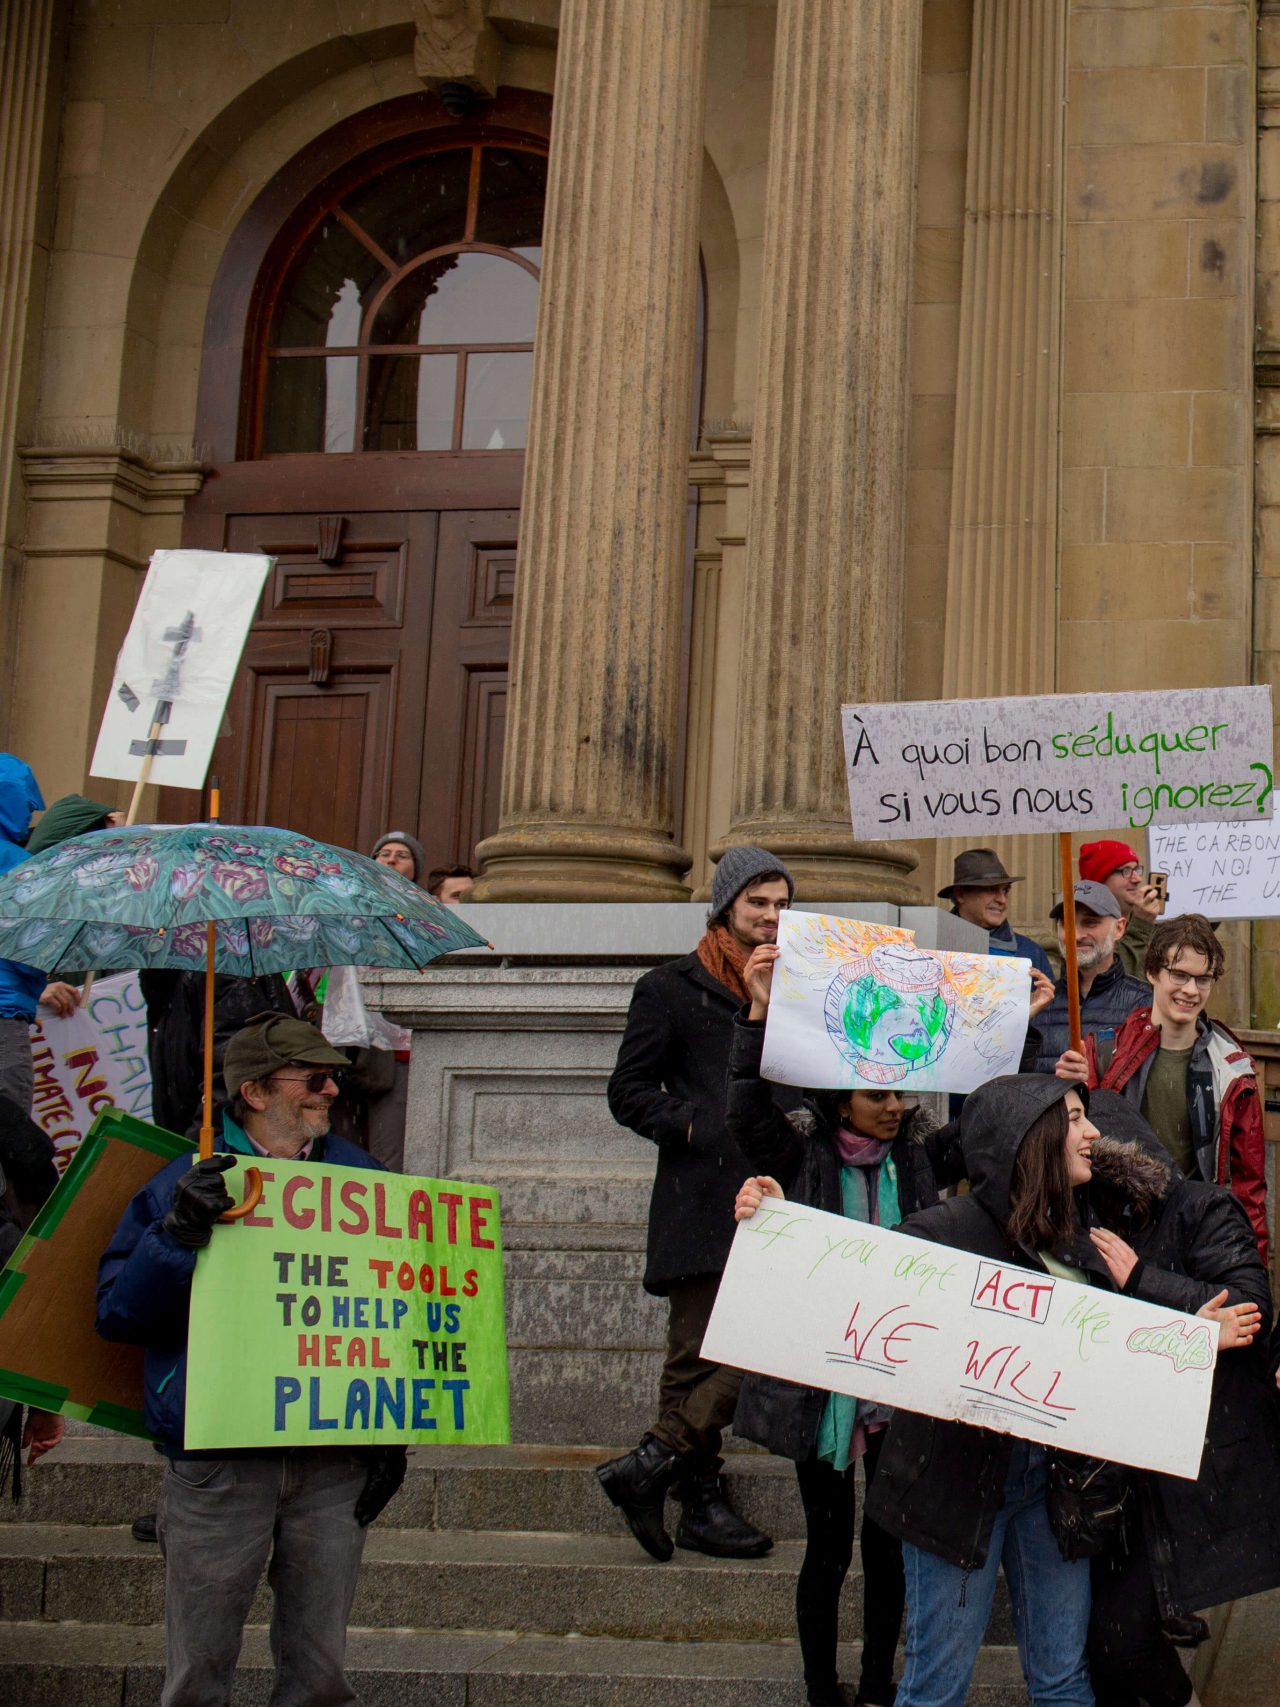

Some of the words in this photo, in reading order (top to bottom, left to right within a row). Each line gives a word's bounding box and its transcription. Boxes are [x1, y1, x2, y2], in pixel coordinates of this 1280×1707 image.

[852, 714, 880, 767] À
[901, 737, 970, 781] quoi
[984, 726, 1041, 764] bon
[878, 790, 911, 823] si
[923, 787, 1002, 819] vous
[1012, 787, 1094, 816] nous
[1121, 762, 1273, 829] ignorez?
[1155, 836, 1188, 854] THE
[1196, 834, 1280, 852] CARBON
[1158, 858, 1194, 877] SAY
[1212, 856, 1252, 877] NO!
[1193, 882, 1239, 904] THE
[273, 1252, 349, 1287] THE
[369, 1259, 478, 1297] TOOLS
[747, 1208, 812, 1250] If
[807, 1235, 878, 1280] you
[976, 1270, 1053, 1318] ACT
[1062, 1295, 1111, 1362] like
[1130, 1322, 1213, 1369] adults
[276, 1293, 321, 1326] TO
[332, 1296, 408, 1329] HELP
[426, 1302, 461, 1334] US
[298, 1334, 390, 1368] HEAL
[412, 1339, 467, 1372] THE
[844, 1301, 939, 1363] WE
[965, 1340, 1077, 1411] WILL
[274, 1376, 470, 1431] PLANET
